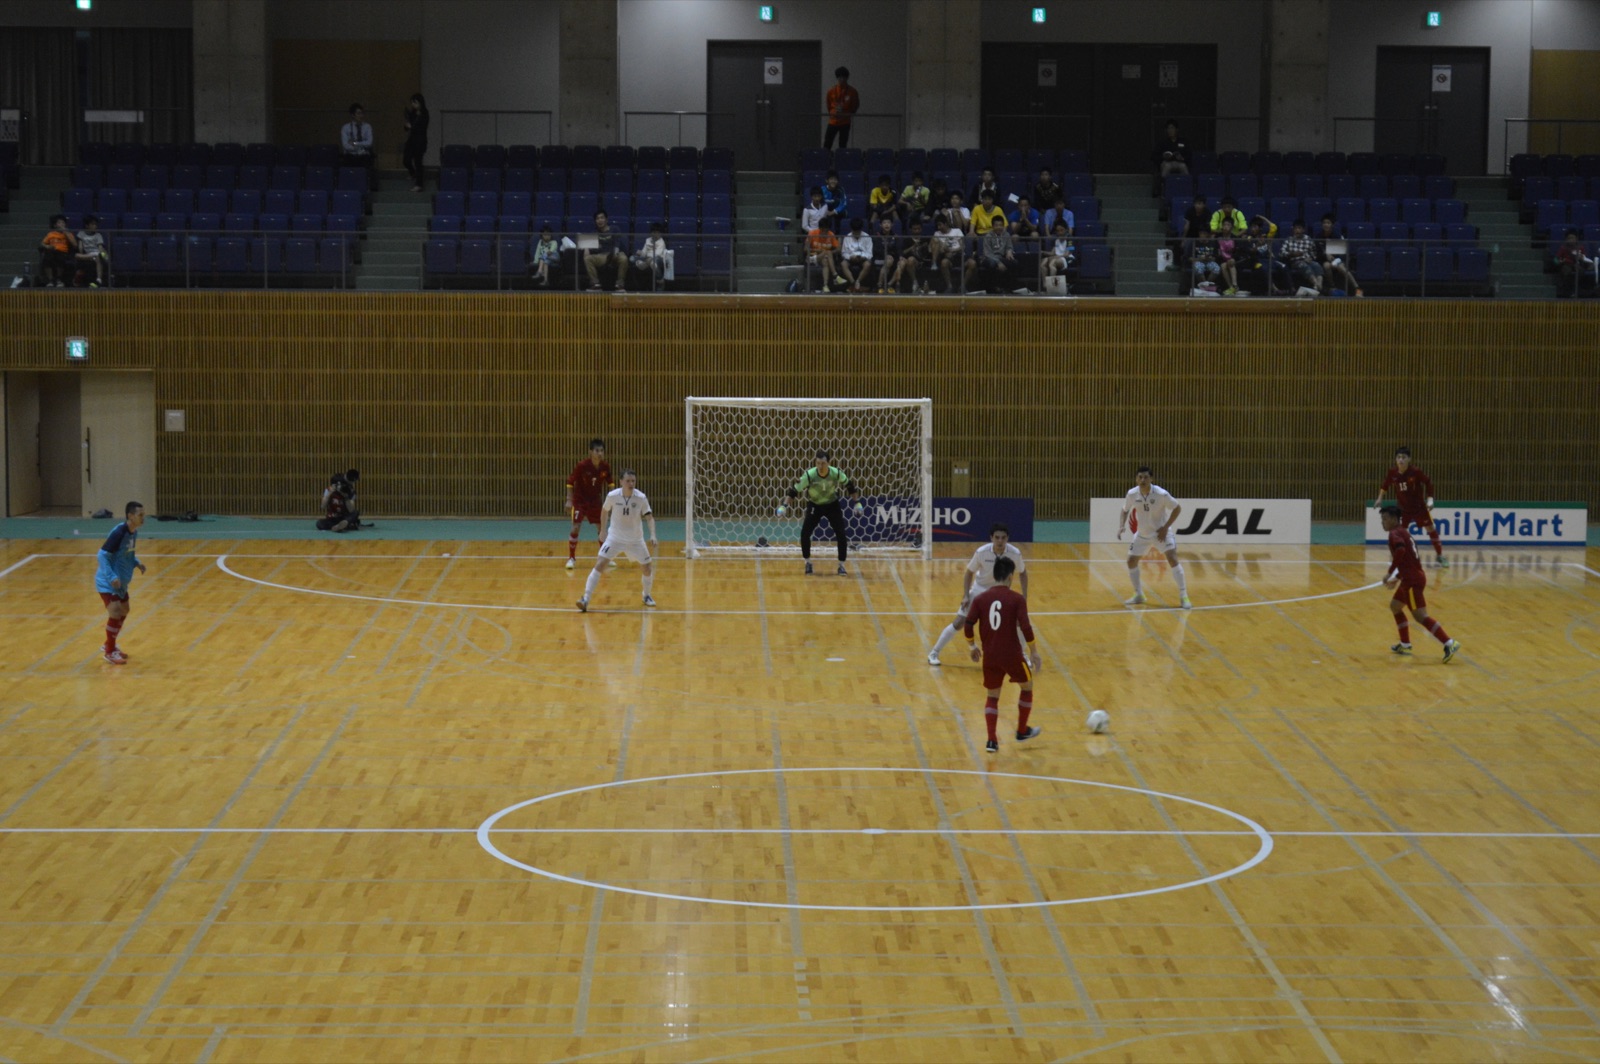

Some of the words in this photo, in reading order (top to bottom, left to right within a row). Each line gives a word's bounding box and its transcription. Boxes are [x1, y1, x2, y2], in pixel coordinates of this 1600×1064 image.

[1398, 481, 1408, 492] 15
[622, 507, 630, 516] 14
[875, 506, 971, 526] MIZHO
[1176, 508, 1272, 535] JAL
[1408, 511, 1563, 540] amilyMart
[989, 600, 1002, 631] 6
